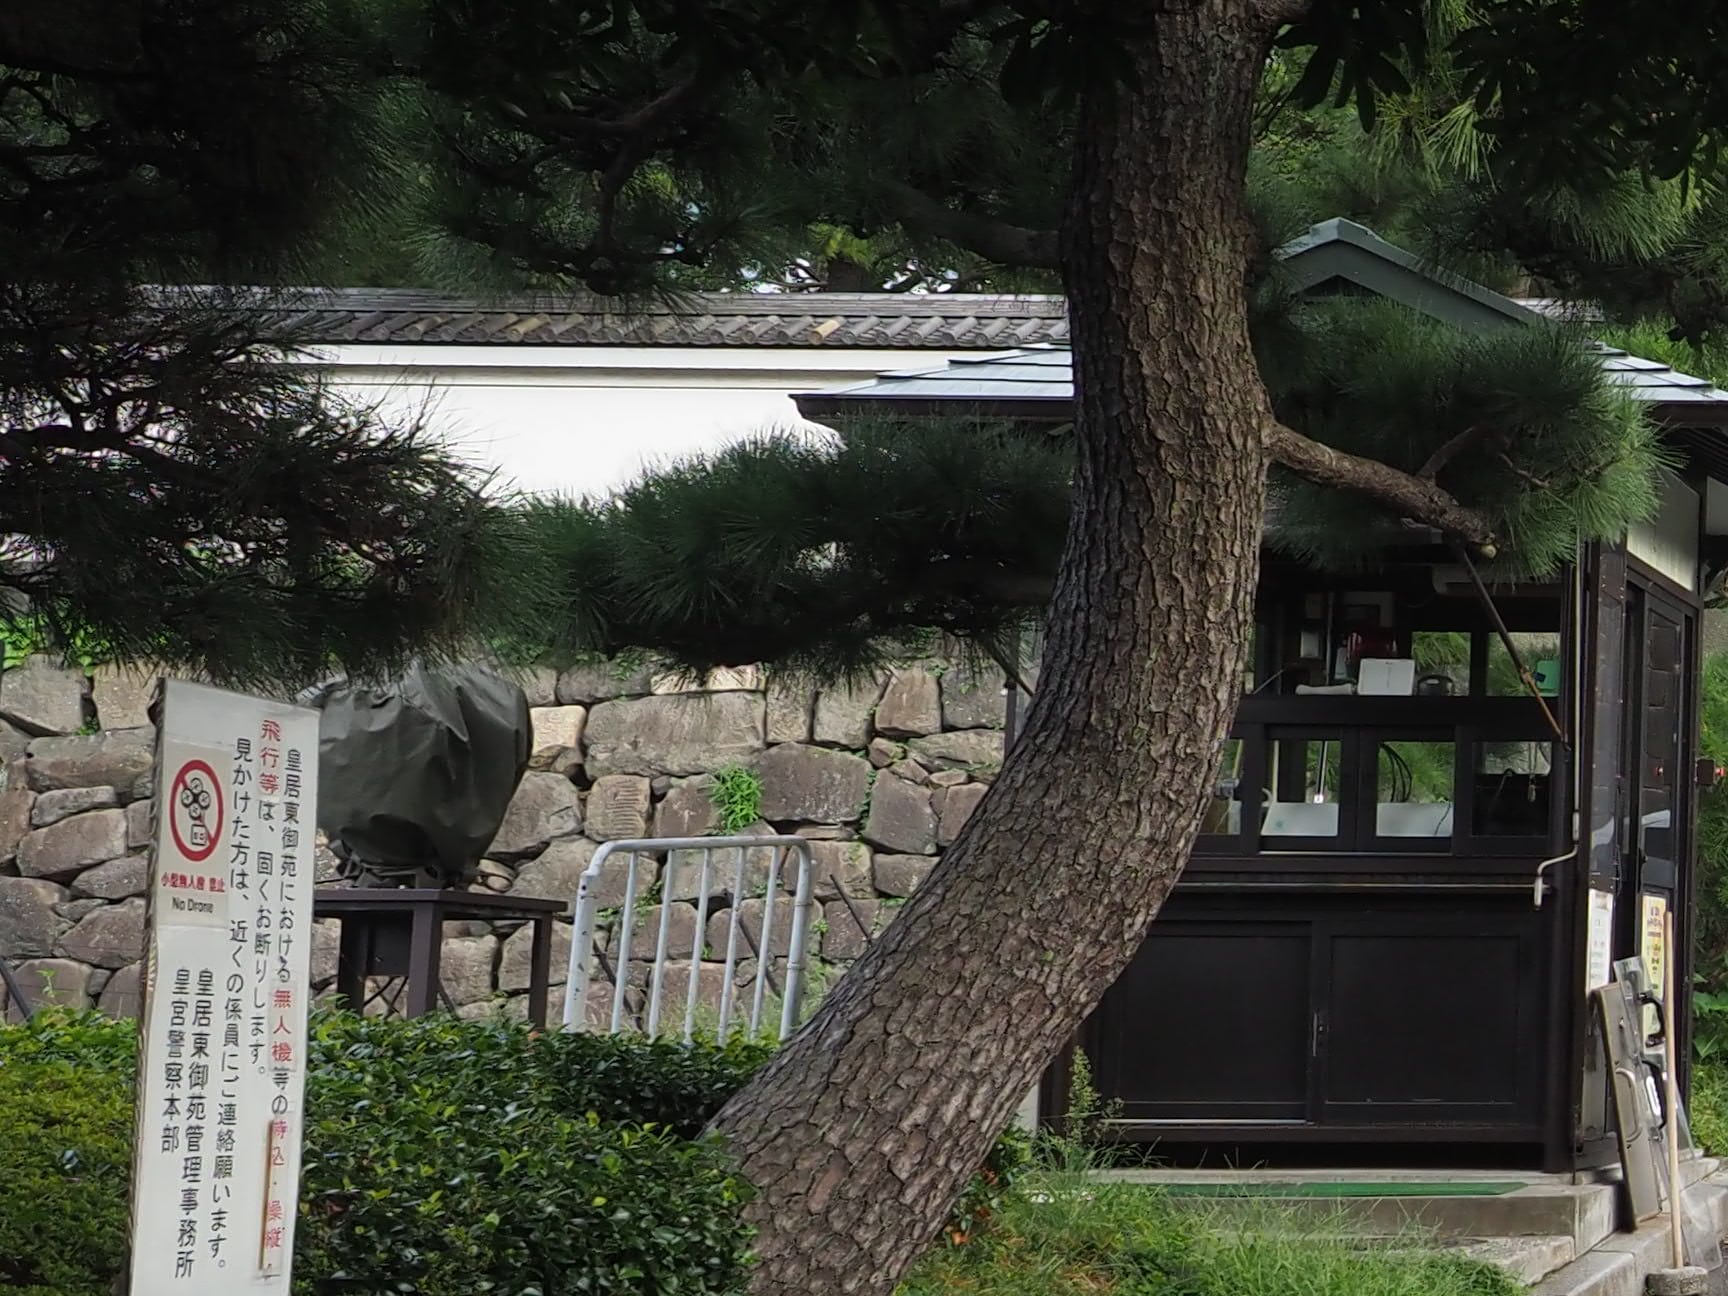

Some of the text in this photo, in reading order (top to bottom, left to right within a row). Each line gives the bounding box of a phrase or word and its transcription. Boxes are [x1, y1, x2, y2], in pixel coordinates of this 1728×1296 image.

[171, 895, 214, 914] No Drone
[161, 966, 190, 1154] 皇宮警察本部
[175, 967, 215, 1279] 皇居東御苑管理事務所
